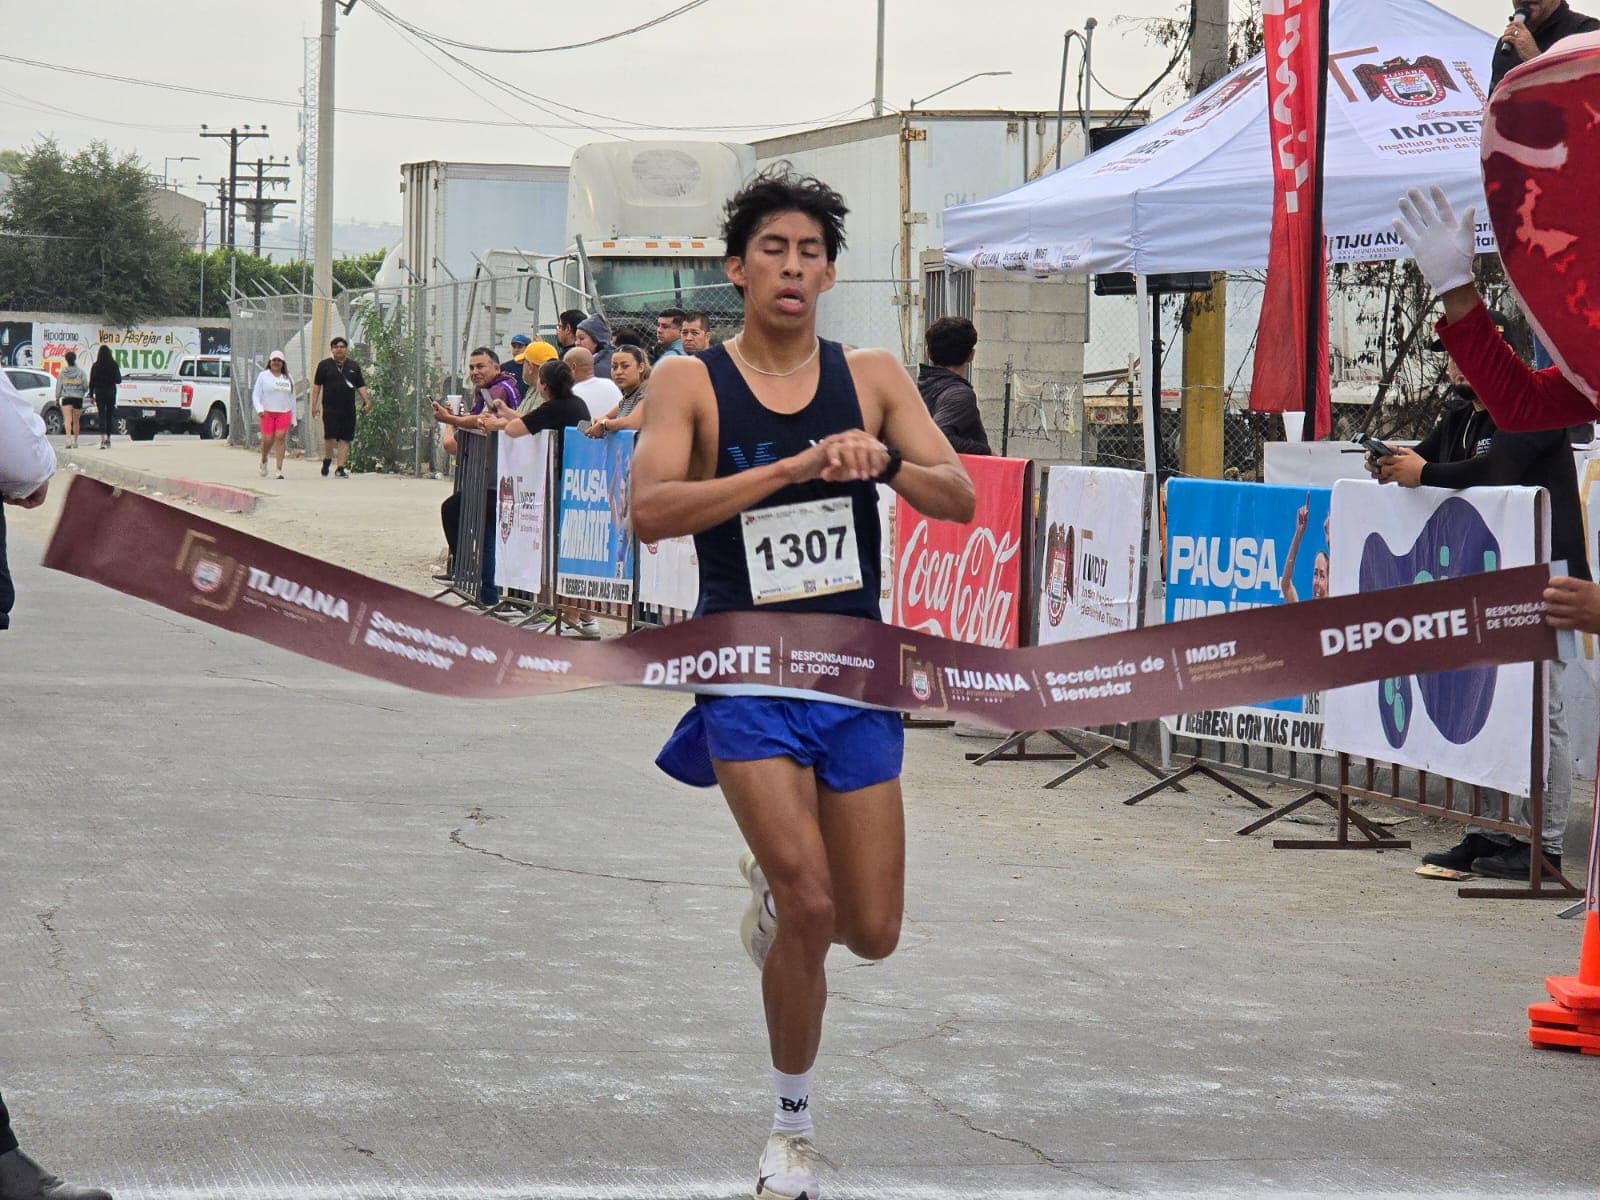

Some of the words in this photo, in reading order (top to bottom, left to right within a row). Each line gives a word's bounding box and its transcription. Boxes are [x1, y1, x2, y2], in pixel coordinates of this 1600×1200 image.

[1378, 139, 1433, 152] Instituto
[1397, 145, 1449, 156] Deporte
[1336, 231, 1404, 250] TIJUAN
[98, 330, 114, 344] Ven
[165, 331, 174, 344] el
[755, 525, 847, 572] 1307
[248, 566, 349, 623] TIJUANA
[1320, 608, 1468, 657] DEPORTE
[1486, 619, 1501, 630] DE
[1503, 614, 1541, 628] TODOS
[791, 650, 875, 670] RESPONSABILIDAD
[1185, 640, 1237, 665] IMDET
[643, 645, 771, 684] DEPORTE
[791, 663, 804, 674] DE
[807, 664, 840, 677] TODOS
[1045, 660, 1137, 686] Secretaría
[1141, 655, 1164, 673] de
[944, 667, 1031, 691] TIJUANA
[1051, 681, 1131, 702] Bienestar
[1185, 710, 1233, 739] REGRESA
[1237, 713, 1262, 741] CON
[1264, 713, 1289, 746] MÁS
